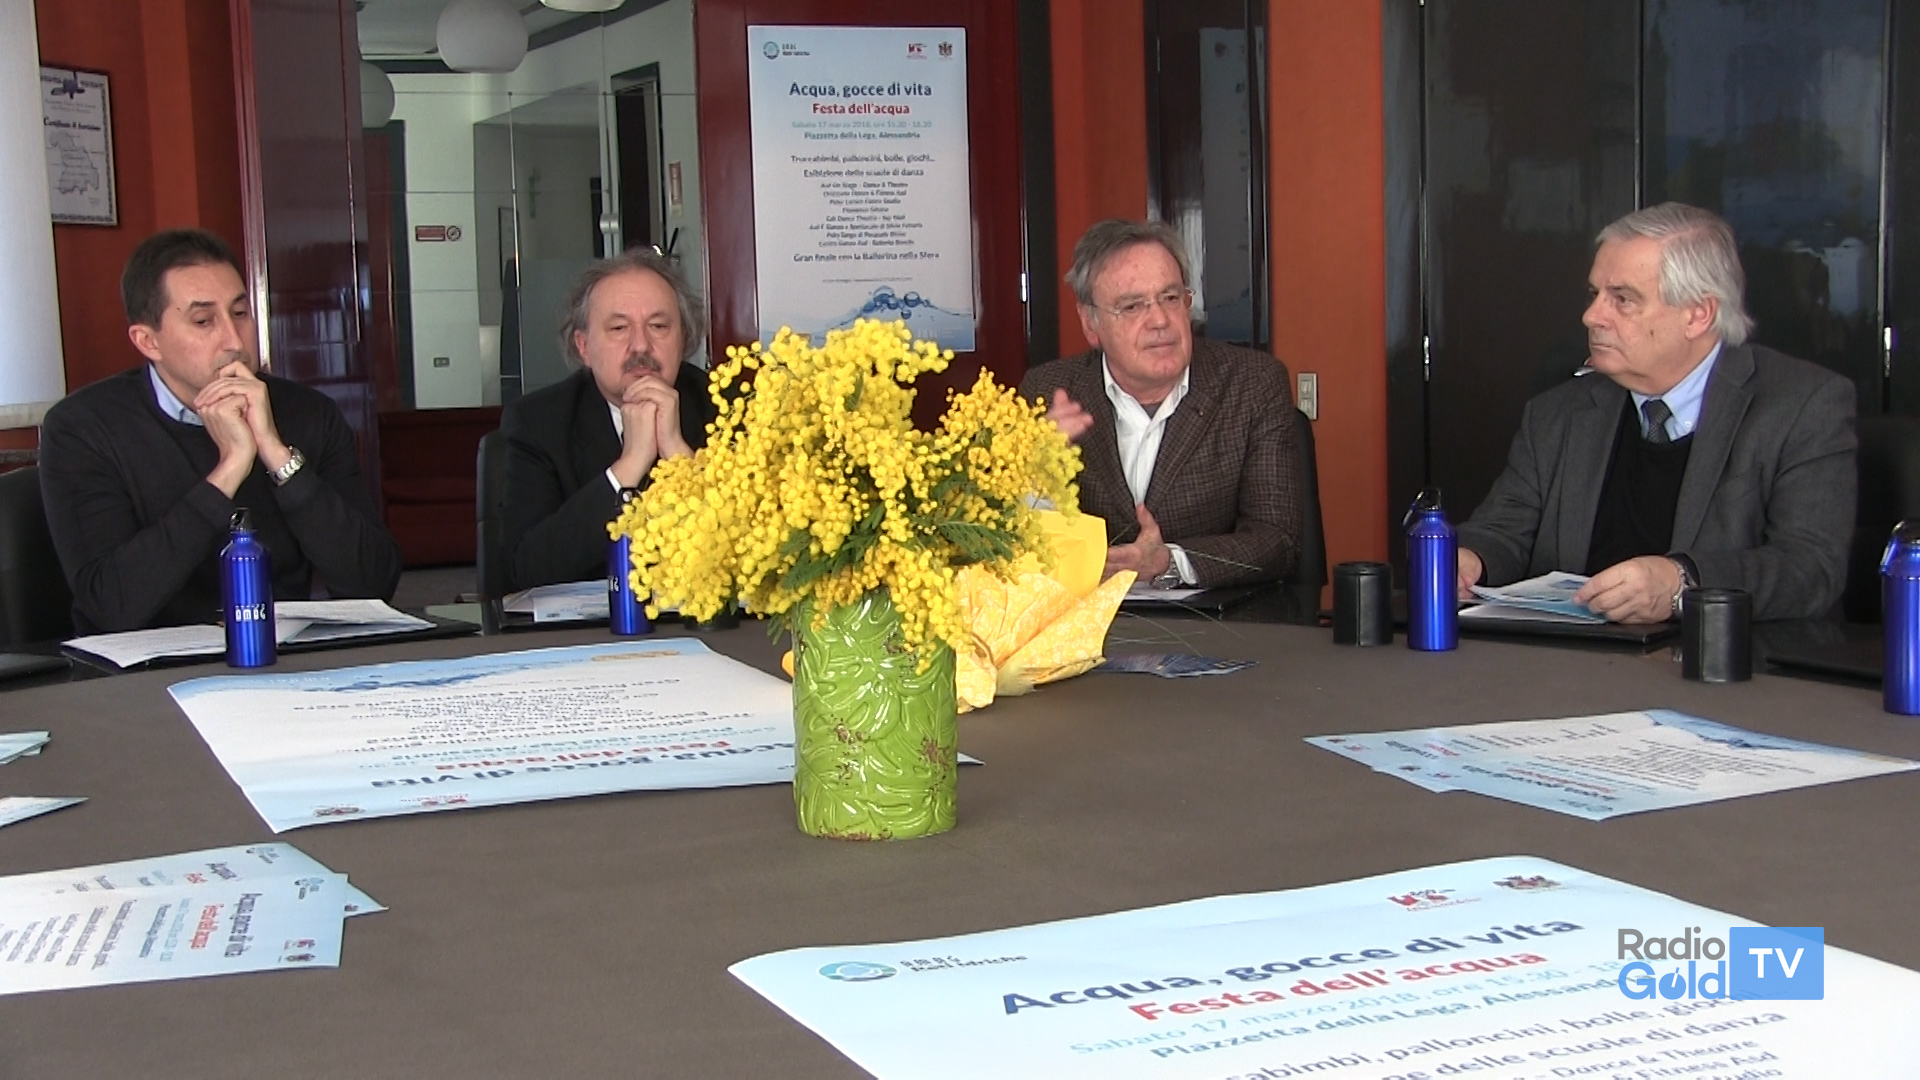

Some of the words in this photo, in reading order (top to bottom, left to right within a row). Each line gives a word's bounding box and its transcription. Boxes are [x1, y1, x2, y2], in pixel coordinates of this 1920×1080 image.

[789, 81, 839, 98] Acqua,
[843, 84, 885, 98] gocce
[887, 81, 901, 96] di
[904, 81, 932, 96] vita
[812, 103, 846, 114] Festa
[848, 103, 910, 116] dell'acqua
[371, 775, 463, 788] vita
[1002, 976, 1223, 1015] Acqua,
[1225, 947, 1401, 982] gocce
[1405, 936, 1467, 954] di
[1463, 921, 1585, 945] vita
[1128, 990, 1286, 1020] Festa
[1290, 953, 1549, 996] dell'acqua
[1070, 1028, 1186, 1054] Sabato
[1191, 1018, 1228, 1033] 17
[1239, 1004, 1337, 1026] marzo
[1432, 981, 1483, 997] ore
[1150, 1023, 1311, 1058] Piazzetta
[1314, 1012, 1395, 1031] della
[1392, 1001, 1482, 1019] Lega,
[1384, 1023, 1569, 1060] palloncini,
[1560, 1009, 1666, 1032] bolle,
[1435, 1055, 1526, 1075] delle
[1528, 1037, 1643, 1060] scuole
[1645, 1028, 1682, 1042] di
[1684, 1012, 1788, 1036] danza
[1550, 1059, 1637, 1078] Dance
[1635, 1055, 1661, 1064] &
[1656, 1041, 1759, 1060] Theatre
[1730, 1051, 1779, 1065] Asd
